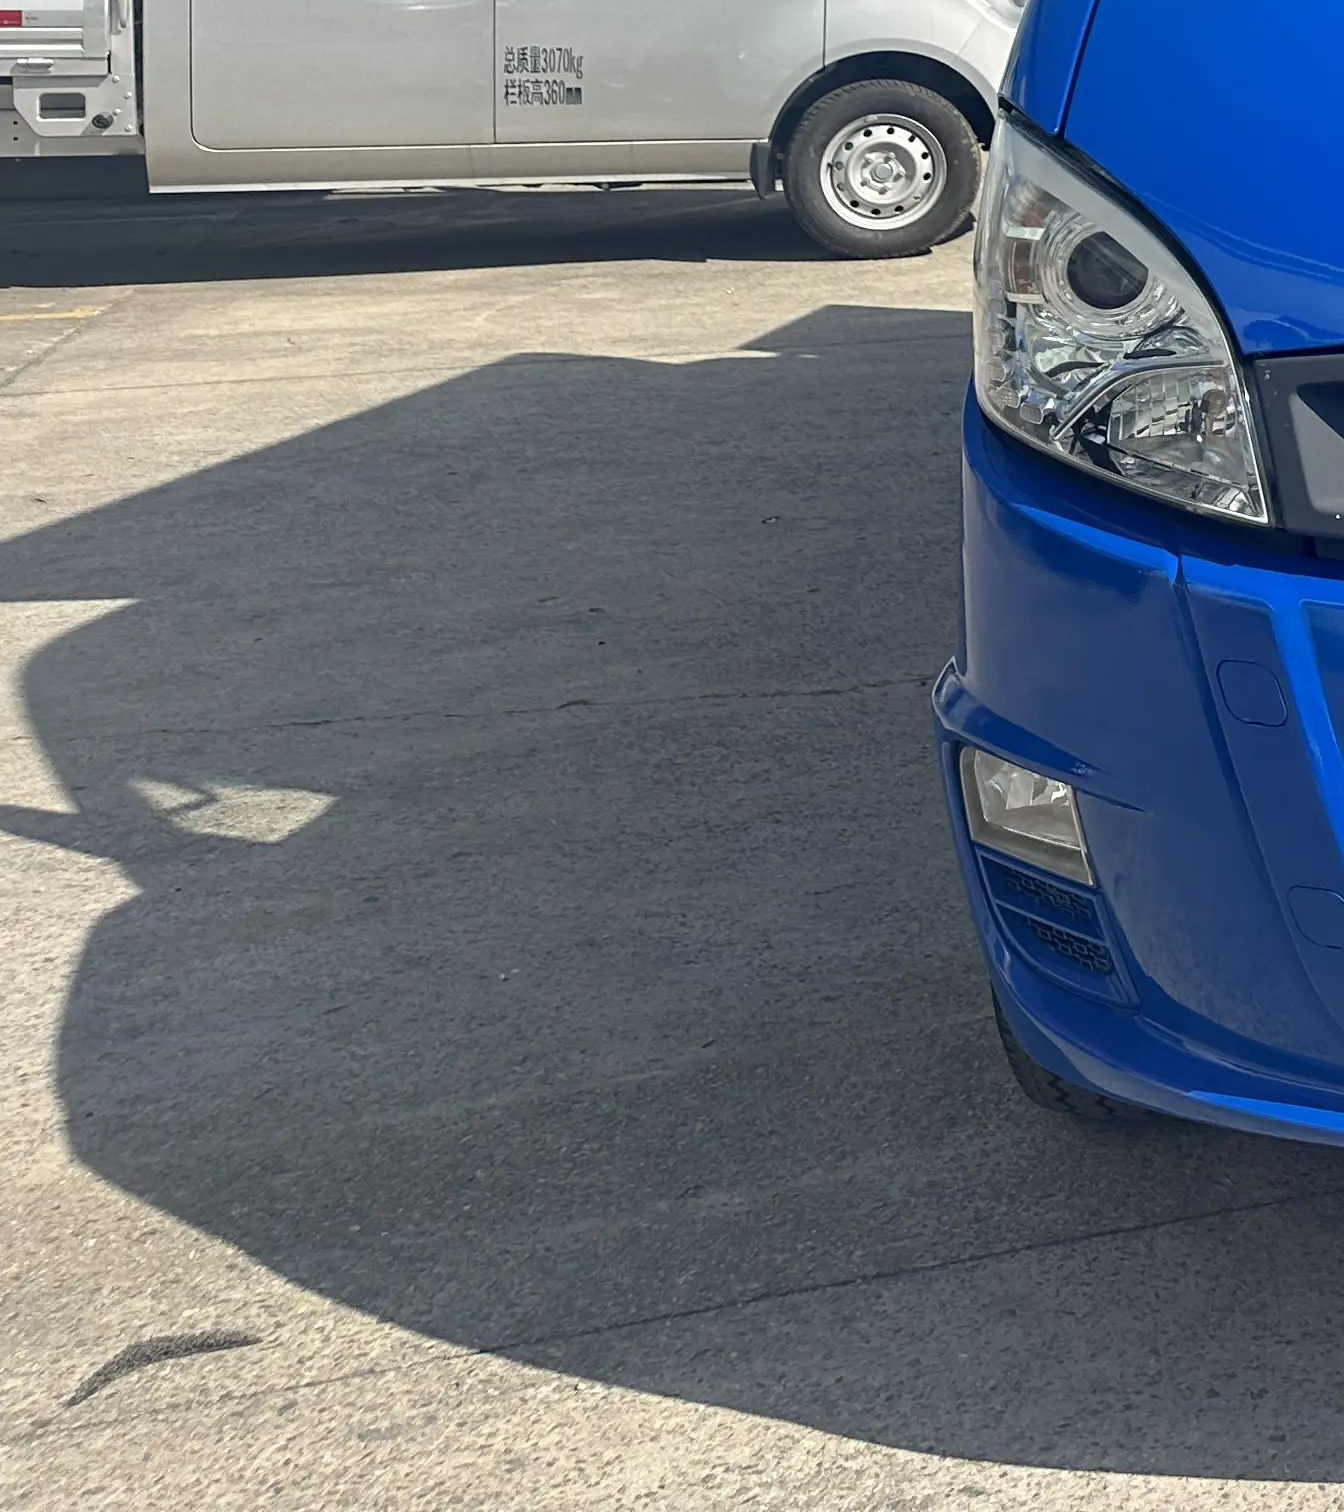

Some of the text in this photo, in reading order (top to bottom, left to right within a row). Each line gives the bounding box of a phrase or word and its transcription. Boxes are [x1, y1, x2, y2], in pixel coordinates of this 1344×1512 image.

[503, 45, 583, 80] 总质量3070kg
[503, 78, 583, 107] 栏板高360mm
